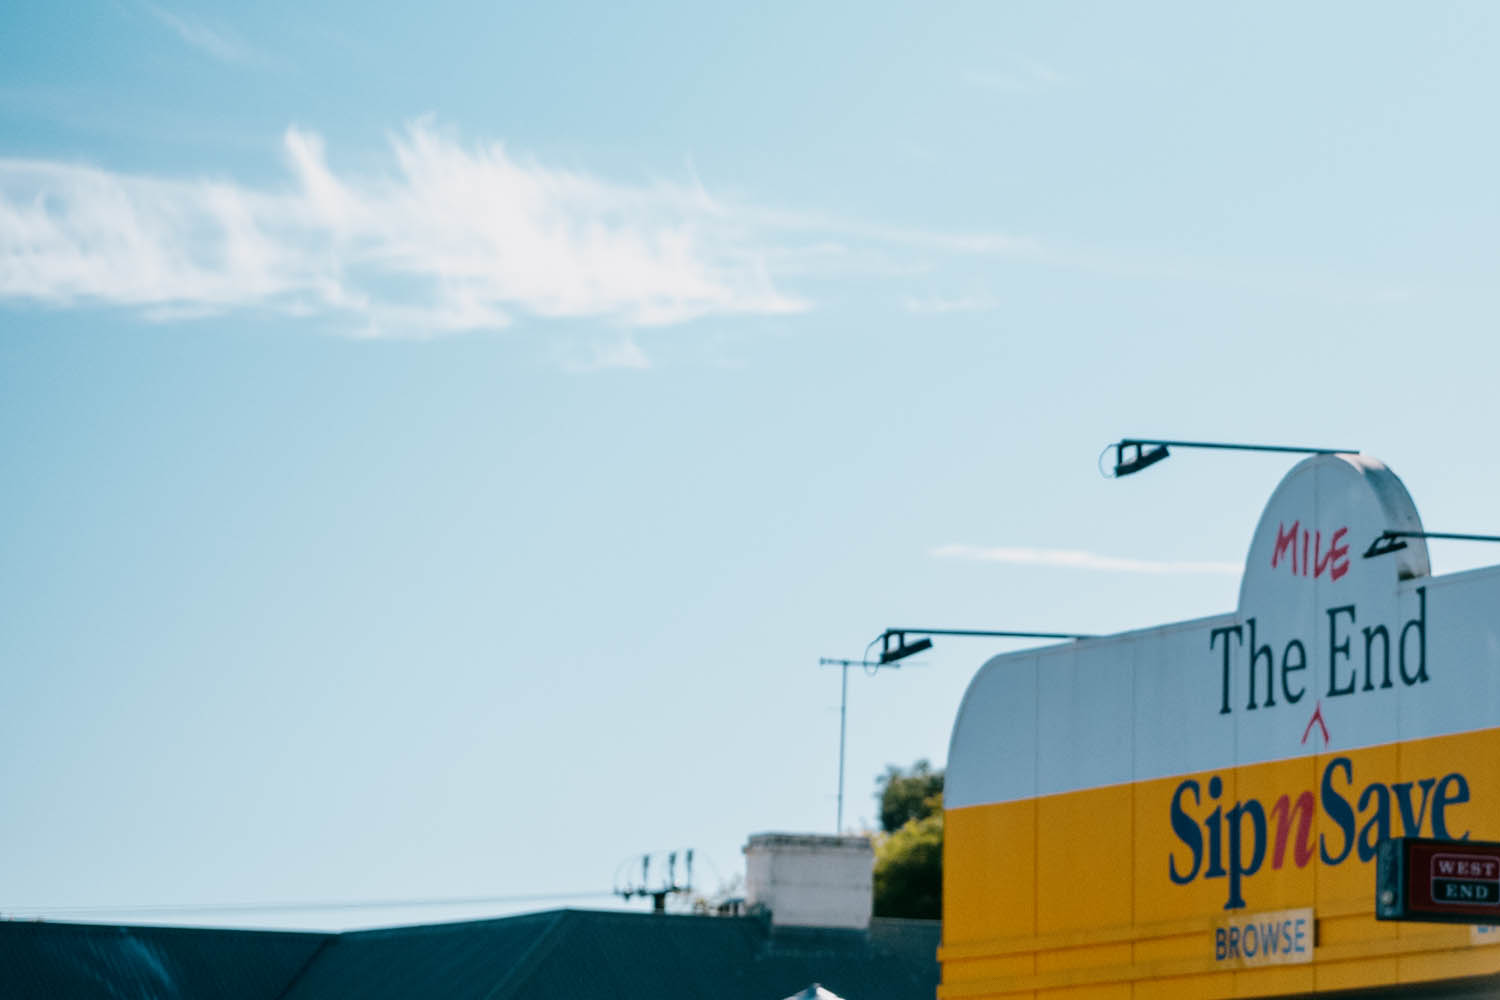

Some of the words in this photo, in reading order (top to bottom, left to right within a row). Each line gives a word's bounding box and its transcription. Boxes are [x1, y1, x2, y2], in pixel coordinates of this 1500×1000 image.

[1271, 519, 1350, 584] MILE
[1209, 616, 1307, 715] The
[1325, 585, 1430, 699] End
[1438, 860, 1496, 877] WEST
[1445, 883, 1489, 900] END
[1215, 918, 1306, 962] BROWSE
